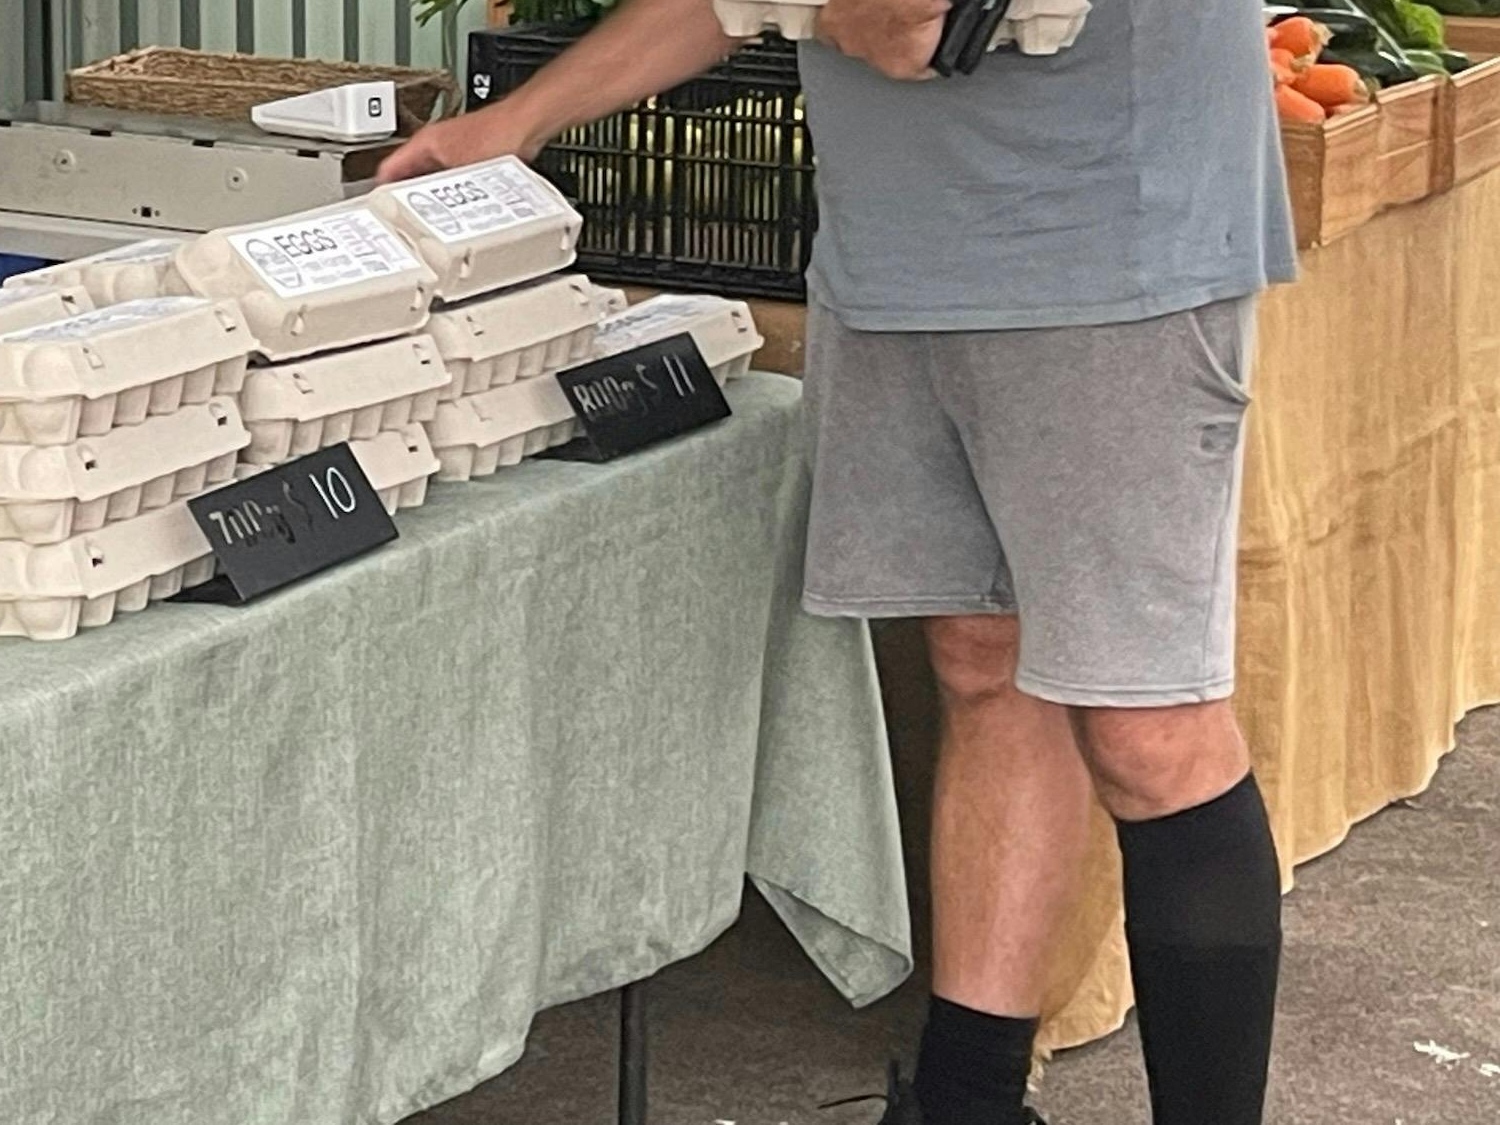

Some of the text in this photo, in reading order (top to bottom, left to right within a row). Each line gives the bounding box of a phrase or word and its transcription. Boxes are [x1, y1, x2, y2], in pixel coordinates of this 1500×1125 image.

[473, 73, 491, 100] 42
[430, 180, 490, 209] EGGS
[273, 228, 339, 259] EGGS
